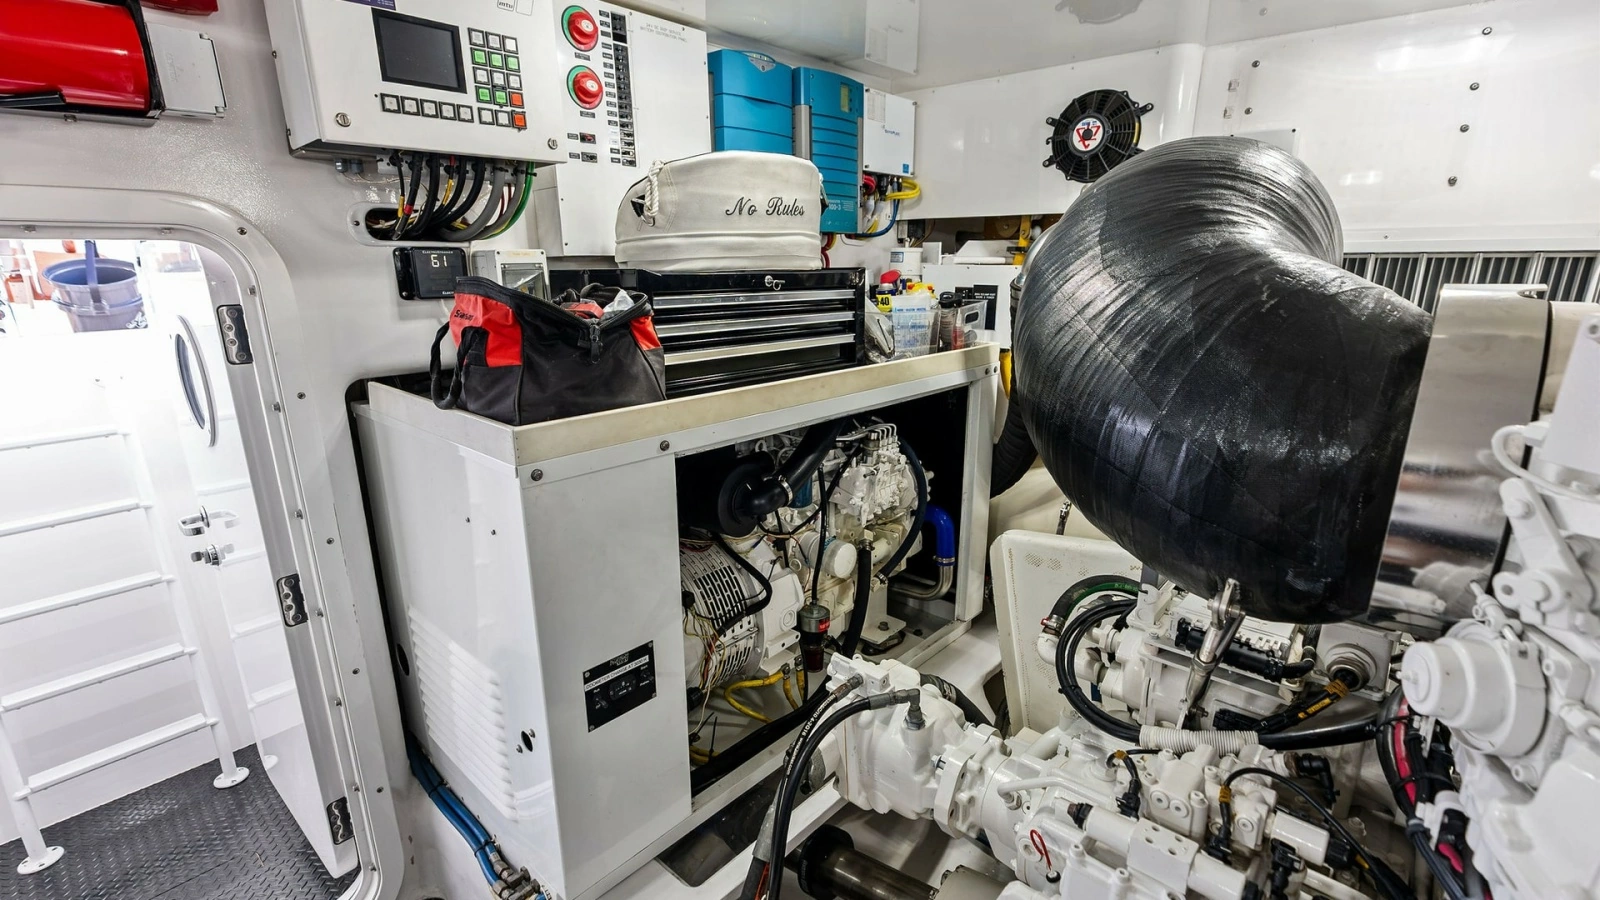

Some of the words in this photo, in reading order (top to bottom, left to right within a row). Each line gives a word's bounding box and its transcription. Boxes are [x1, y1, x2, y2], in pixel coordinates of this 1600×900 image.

[725, 196, 758, 216] No
[765, 196, 805, 216] Rules
[431, 254, 447, 267] 61
